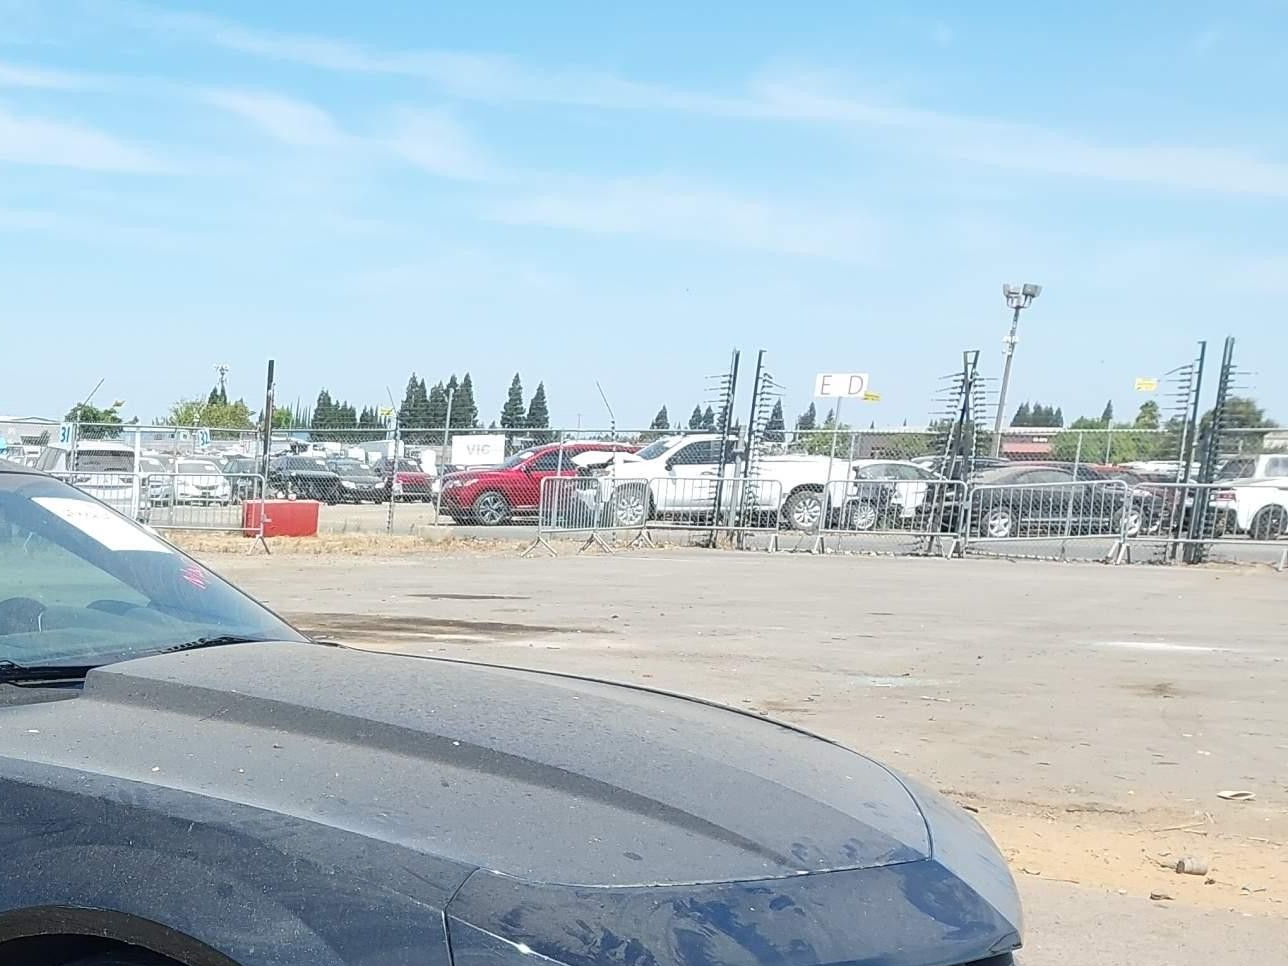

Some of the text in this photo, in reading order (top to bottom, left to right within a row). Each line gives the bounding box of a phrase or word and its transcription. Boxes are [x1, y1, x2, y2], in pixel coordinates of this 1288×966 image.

[820, 375, 863, 395] E D
[60, 426, 71, 443] 31
